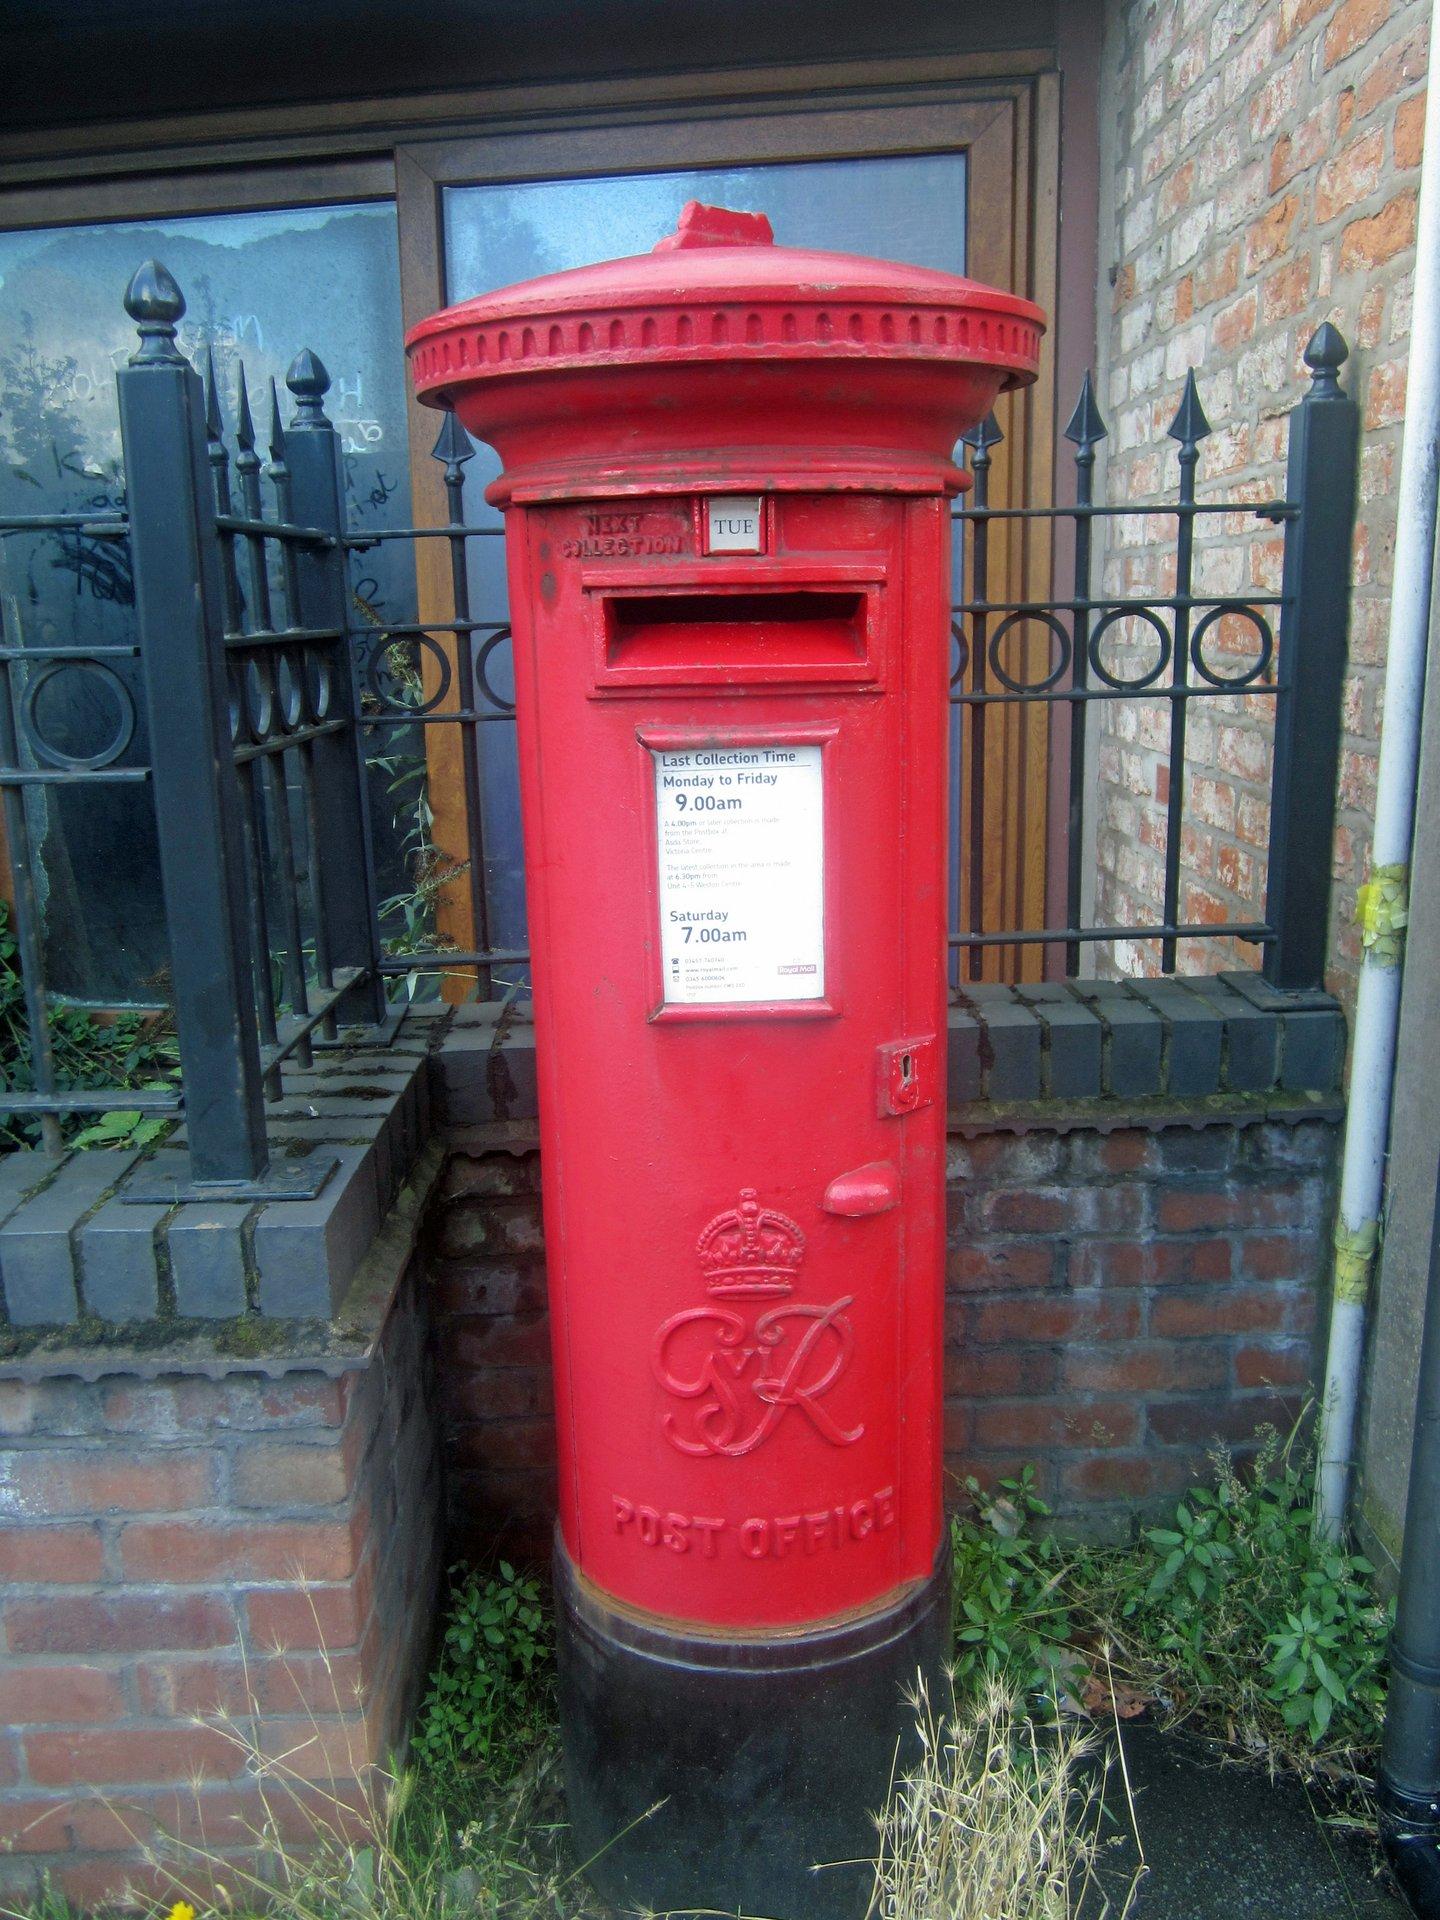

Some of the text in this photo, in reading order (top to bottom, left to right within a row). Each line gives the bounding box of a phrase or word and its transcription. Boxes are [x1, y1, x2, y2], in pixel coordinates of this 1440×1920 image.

[714, 519, 754, 535] TUE
[662, 750, 796, 767] Last Collection Time
[663, 772, 778, 788] Monday to Friday
[675, 793, 742, 811] 9.00am
[670, 910, 729, 923] Saturday
[681, 926, 747, 944] 7.00am
[612, 1486, 894, 1559] POST OFFICE
